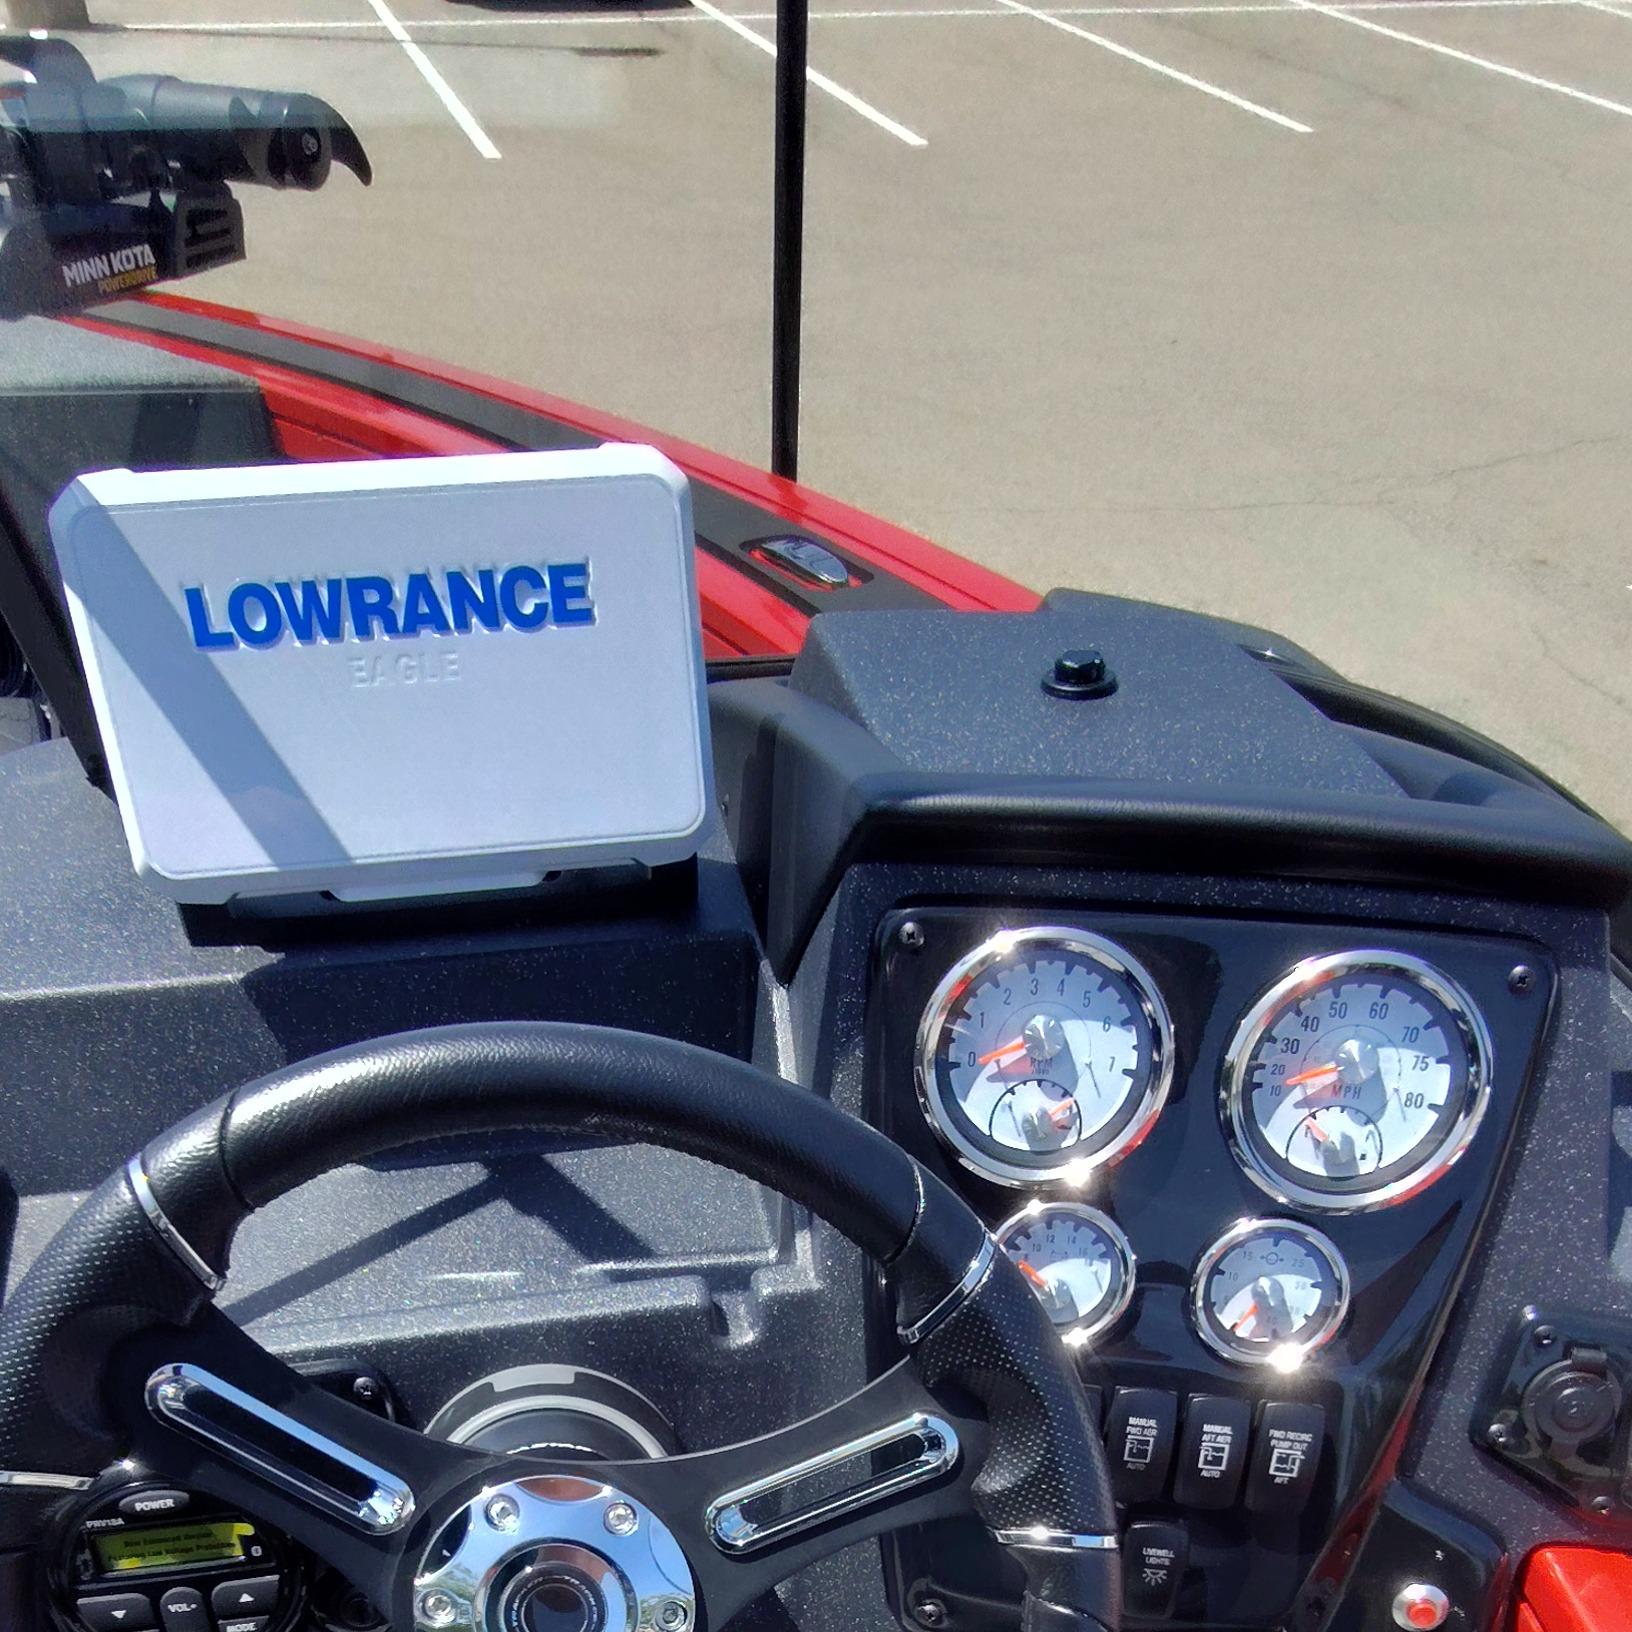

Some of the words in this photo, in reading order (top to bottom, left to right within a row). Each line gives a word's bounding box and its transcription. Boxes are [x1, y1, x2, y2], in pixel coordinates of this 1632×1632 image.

[62, 254, 110, 287] MINN
[110, 244, 156, 274] KOTA
[184, 562, 597, 652] LOWRANCE
[348, 652, 462, 688] EAGLE
[1031, 978, 1039, 996] 3
[1056, 978, 1065, 998] 4
[1003, 988, 1012, 1006] 2
[1083, 990, 1091, 1008] 5
[1328, 1002, 1348, 1019] 50
[1369, 1003, 1389, 1020] 60
[980, 1012, 985, 1028] 1
[1103, 1016, 1111, 1032] 6
[1300, 1016, 1320, 1033] 40
[1401, 1026, 1420, 1044] 70
[1280, 1038, 1300, 1055] 30
[968, 1052, 976, 1068] 0
[1108, 1056, 1115, 1072] 7
[1411, 1056, 1429, 1072] 75
[1270, 1064, 1286, 1076] 20
[1270, 1085, 1281, 1097] 10
[1330, 1084, 1362, 1100] MPH
[1404, 1092, 1424, 1109] 80
[1128, 1416, 1158, 1427] MANUAL
[1200, 1470, 1221, 1478] AUTO
[134, 1499, 175, 1512] POWER
